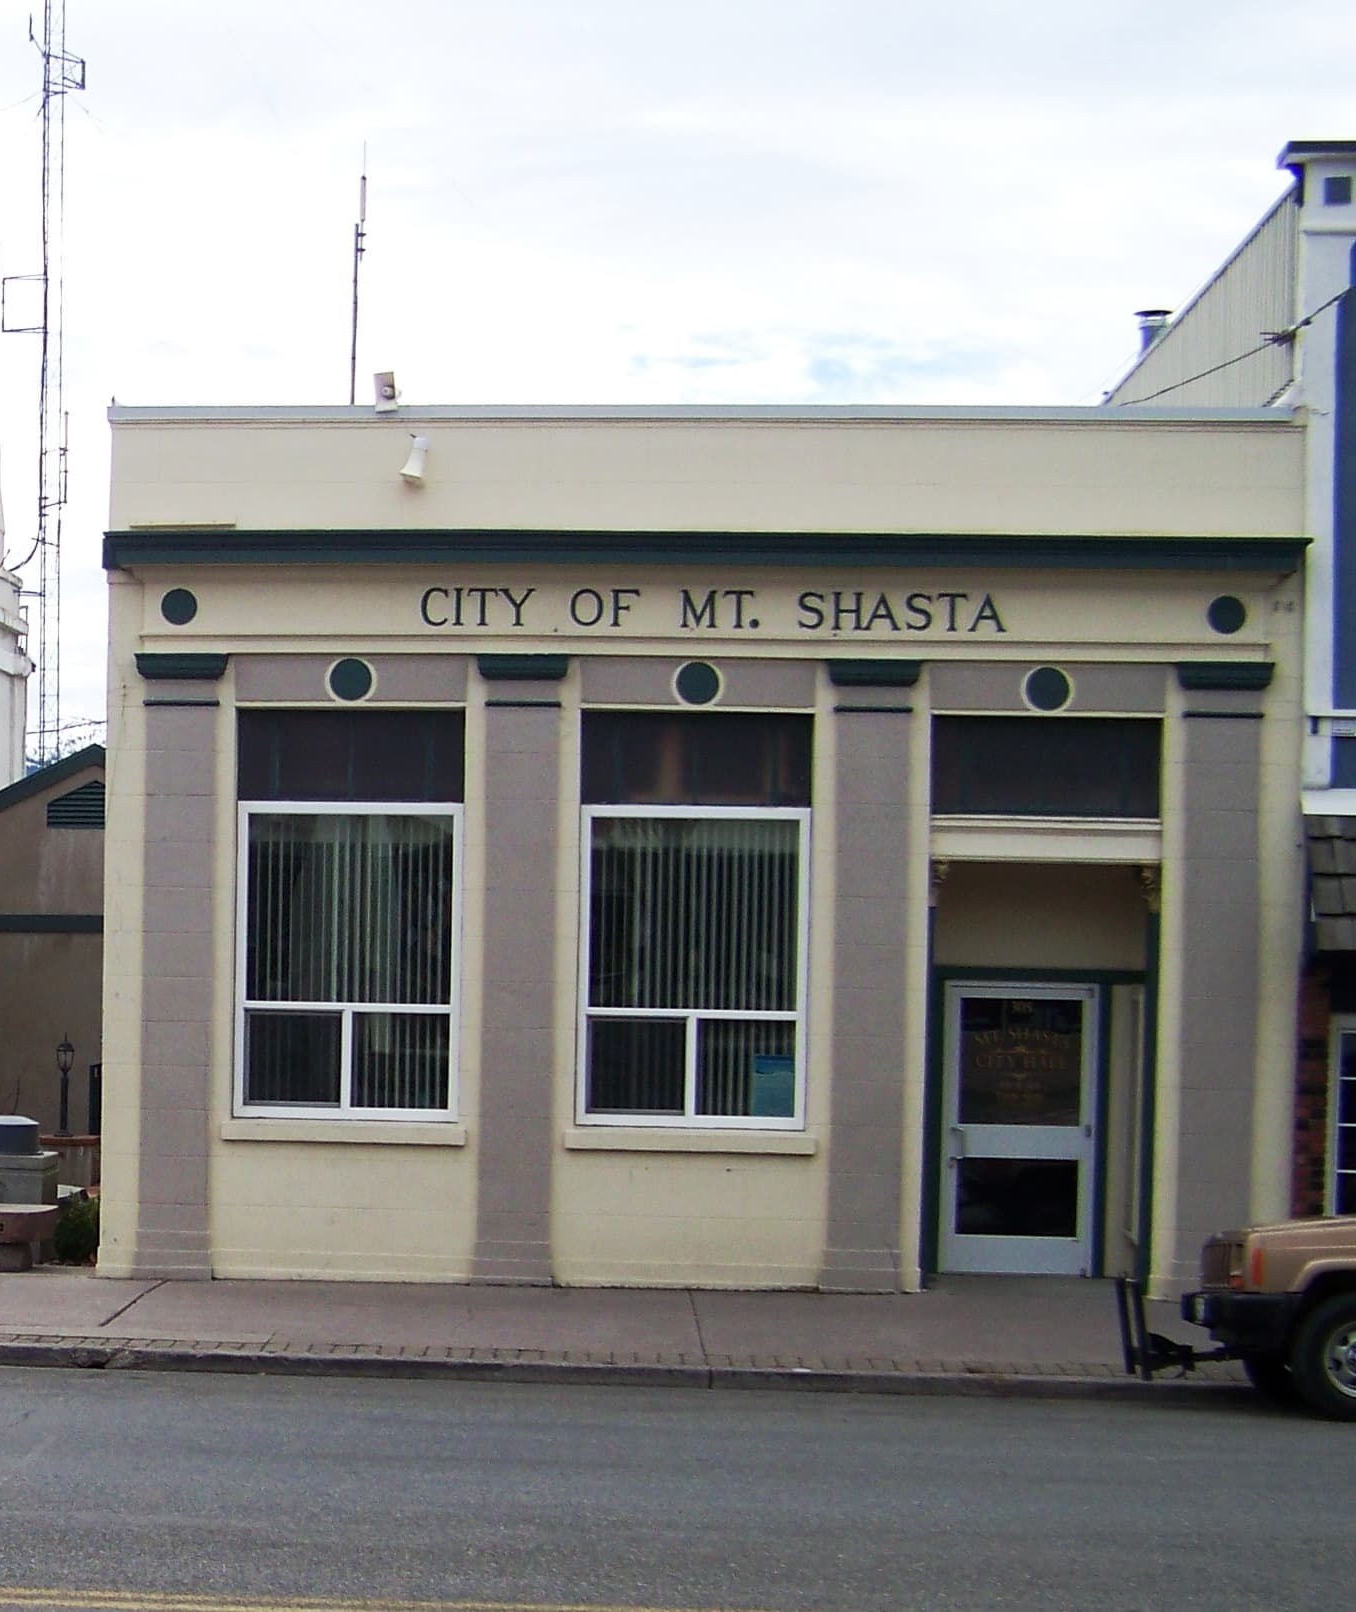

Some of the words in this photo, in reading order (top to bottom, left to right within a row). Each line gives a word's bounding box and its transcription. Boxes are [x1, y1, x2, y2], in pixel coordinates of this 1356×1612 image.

[419, 586, 537, 628] CITY
[569, 587, 641, 630] OF
[679, 589, 761, 631] MT.
[797, 591, 1007, 634] SHASTA
